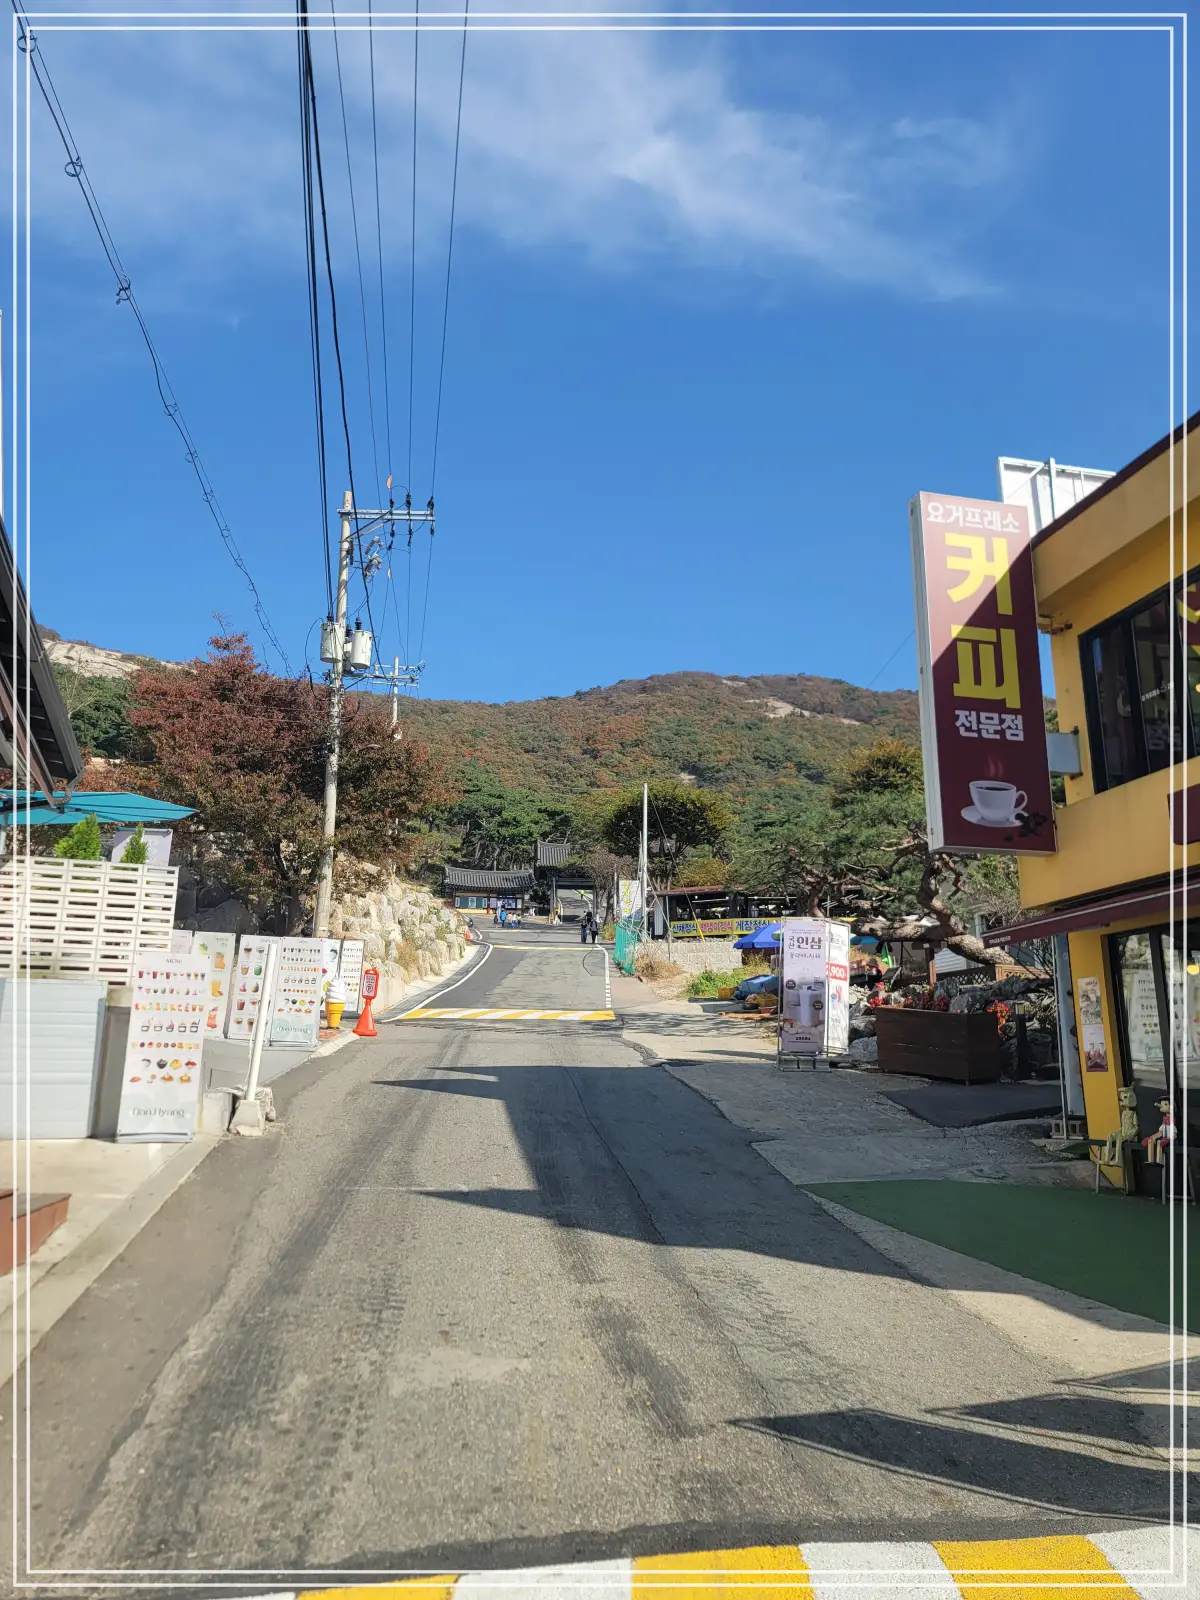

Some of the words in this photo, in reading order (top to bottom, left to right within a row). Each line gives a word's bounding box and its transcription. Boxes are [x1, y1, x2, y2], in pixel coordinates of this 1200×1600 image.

[926, 502, 1020, 533] 요거프레소
[944, 532, 1021, 709] 커피
[954, 709, 1025, 742] 전문점
[797, 936, 822, 950] 인삼
